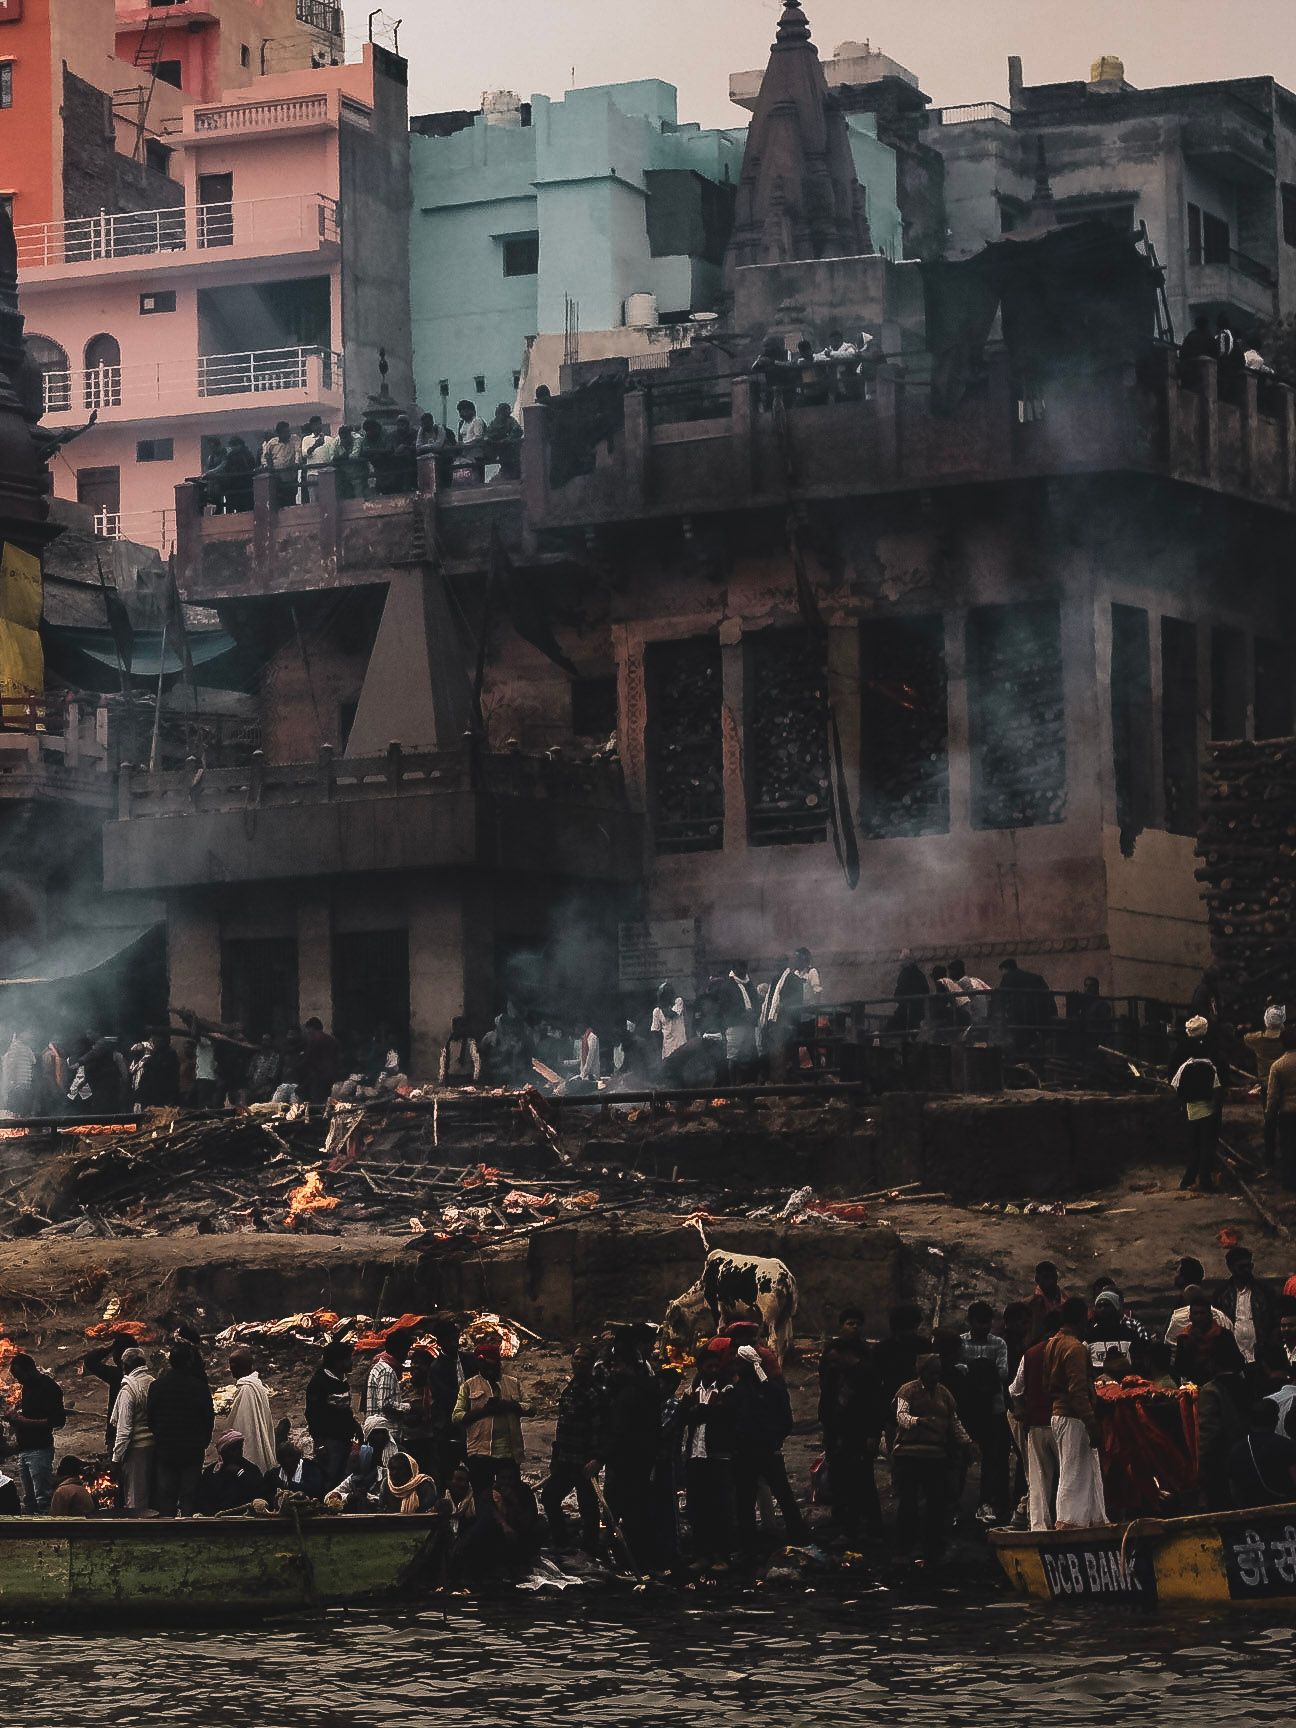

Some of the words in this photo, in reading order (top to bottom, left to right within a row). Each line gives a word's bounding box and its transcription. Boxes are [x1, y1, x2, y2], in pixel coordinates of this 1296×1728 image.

[1044, 1552, 1083, 1596] DCB
[1084, 1550, 1142, 1593] BANK
[1232, 1528, 1270, 1587] डी
[1271, 1524, 1296, 1584] स
